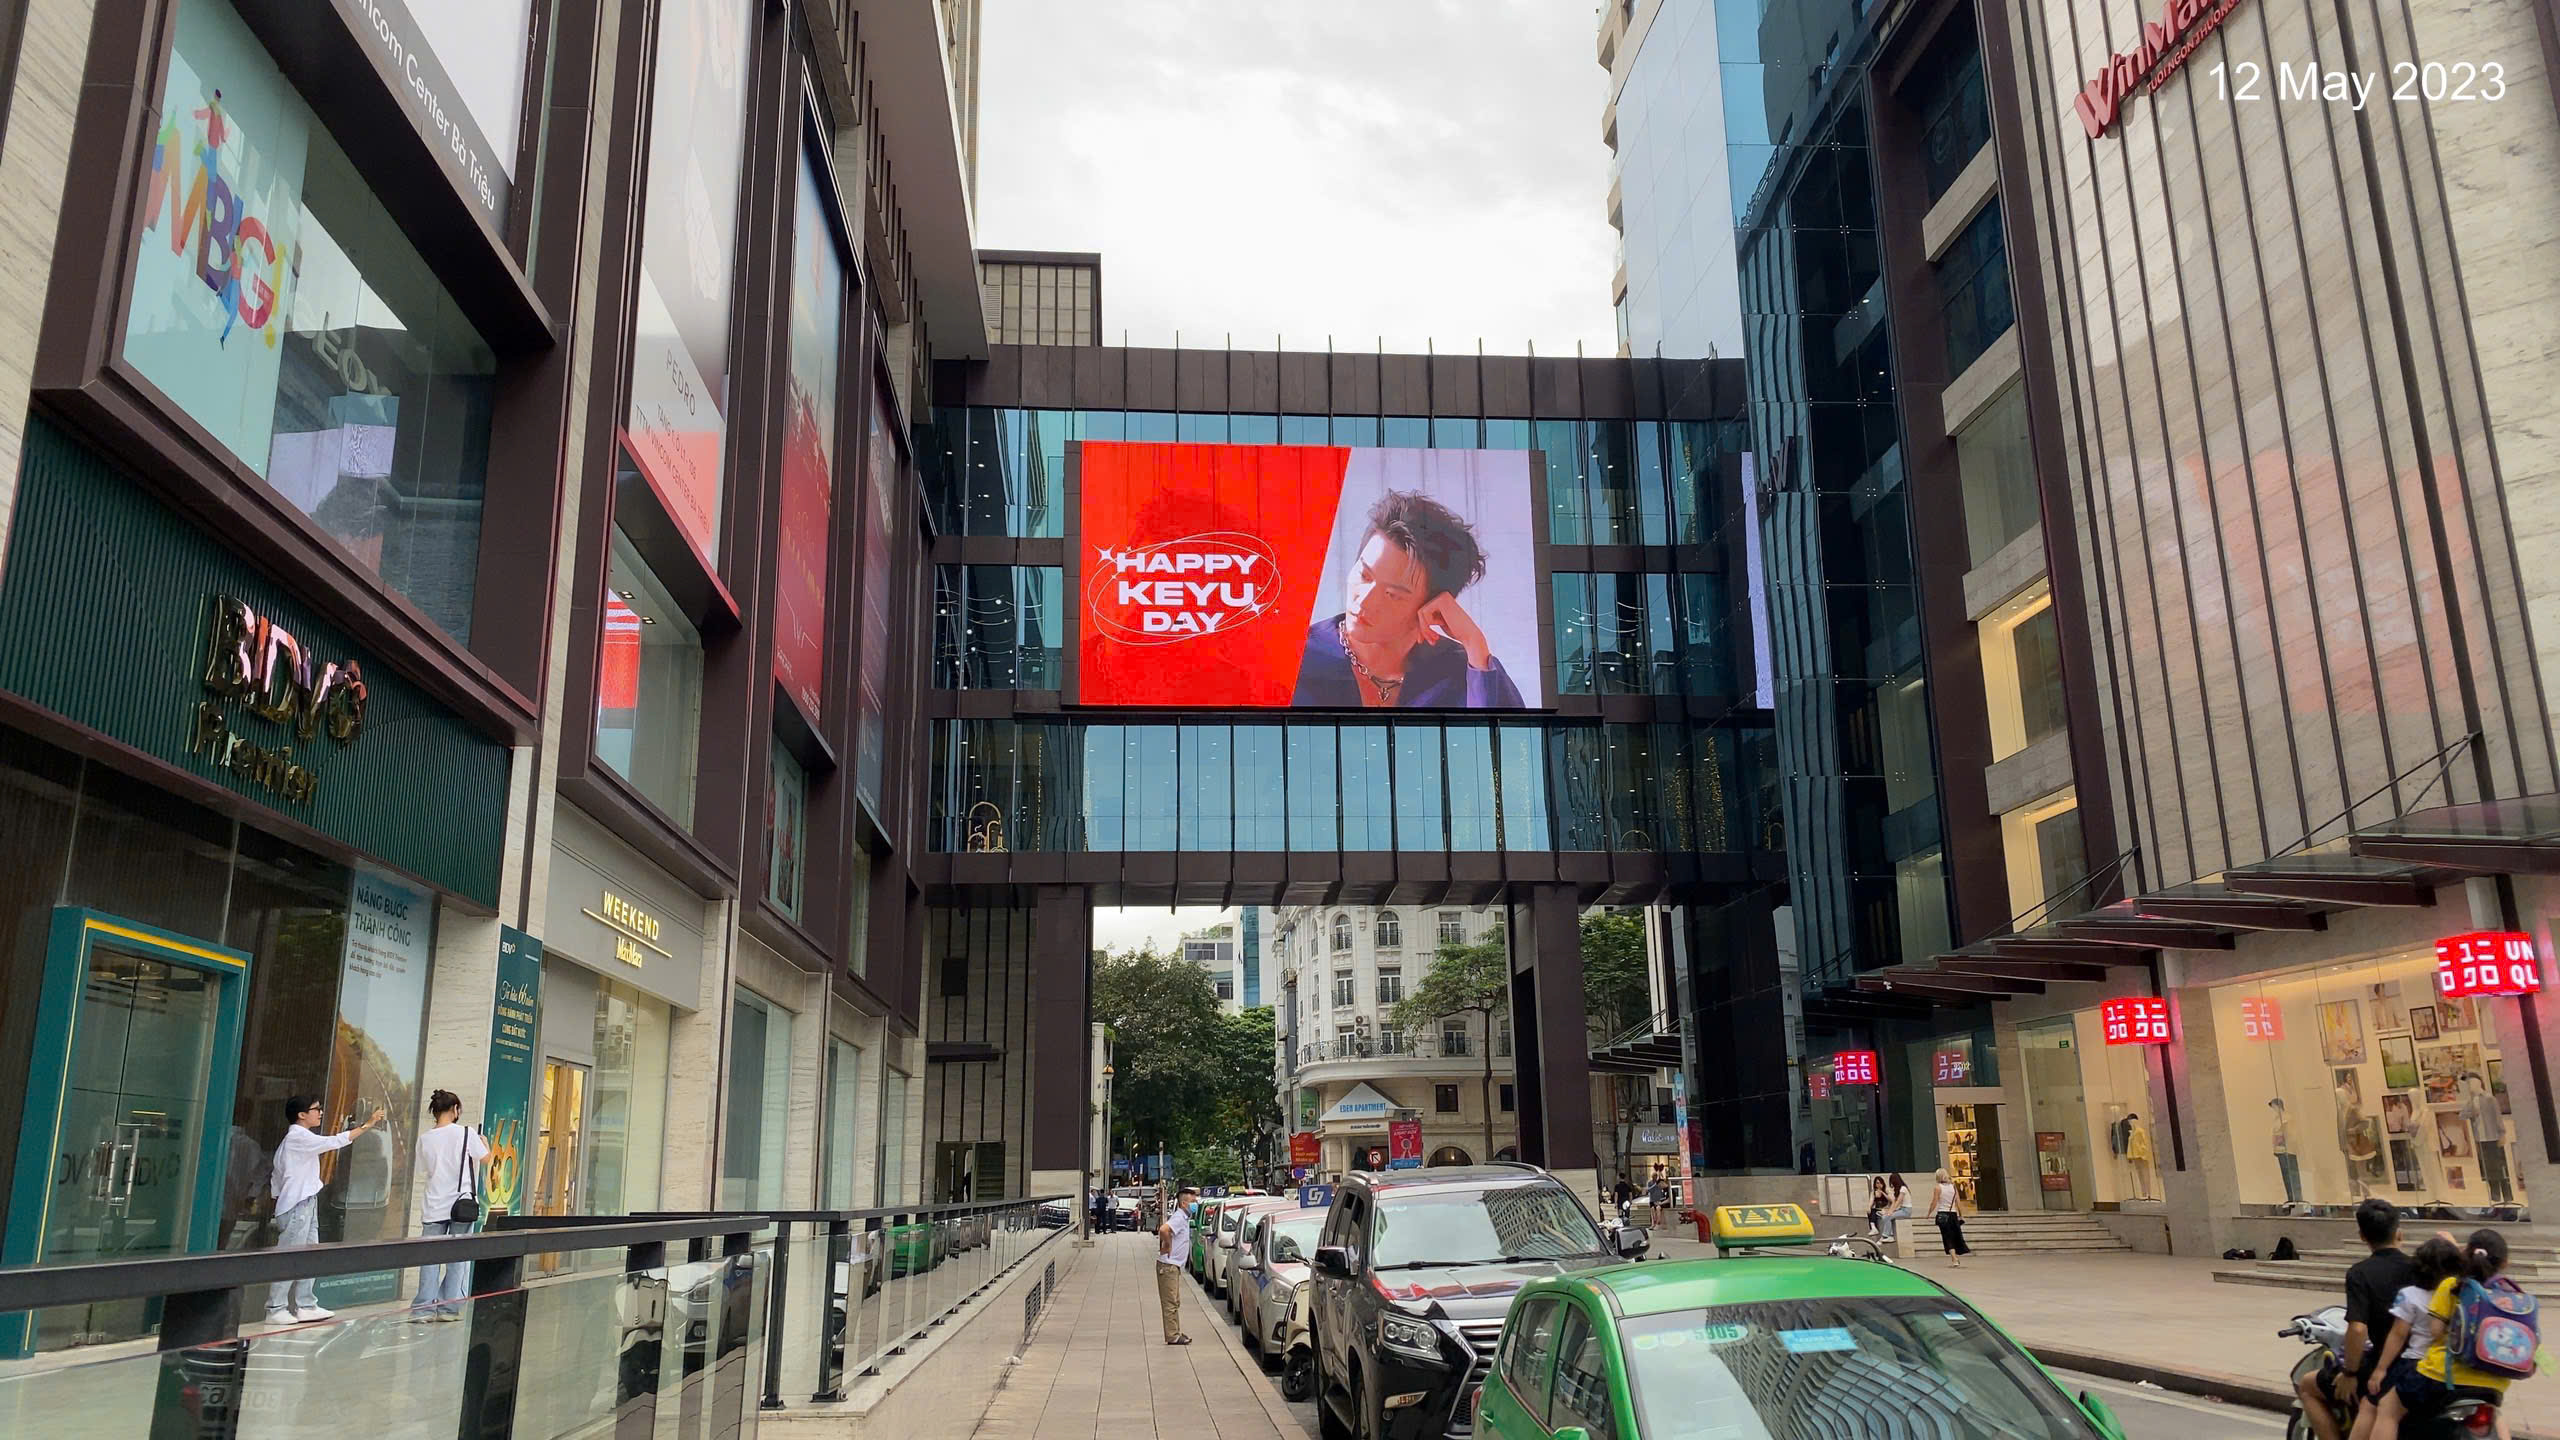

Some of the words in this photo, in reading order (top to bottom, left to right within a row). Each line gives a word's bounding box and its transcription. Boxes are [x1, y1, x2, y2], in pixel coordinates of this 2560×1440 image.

[2074, 0, 2214, 139] WinMa
[406, 53, 450, 137] Center
[451, 122, 466, 167] Bà
[469, 149, 495, 211] Triệu
[666, 349, 696, 416] PEDRO
[1117, 552, 1259, 575] HAPPY
[1118, 581, 1255, 607] KEYU
[1143, 611, 1225, 633] DAY
[603, 891, 660, 941] WEEKEND
[1340, 1104, 1354, 1112] EDEN
[1354, 1102, 1386, 1112] APARTMENT
[1308, 1187, 1325, 1206] G7
